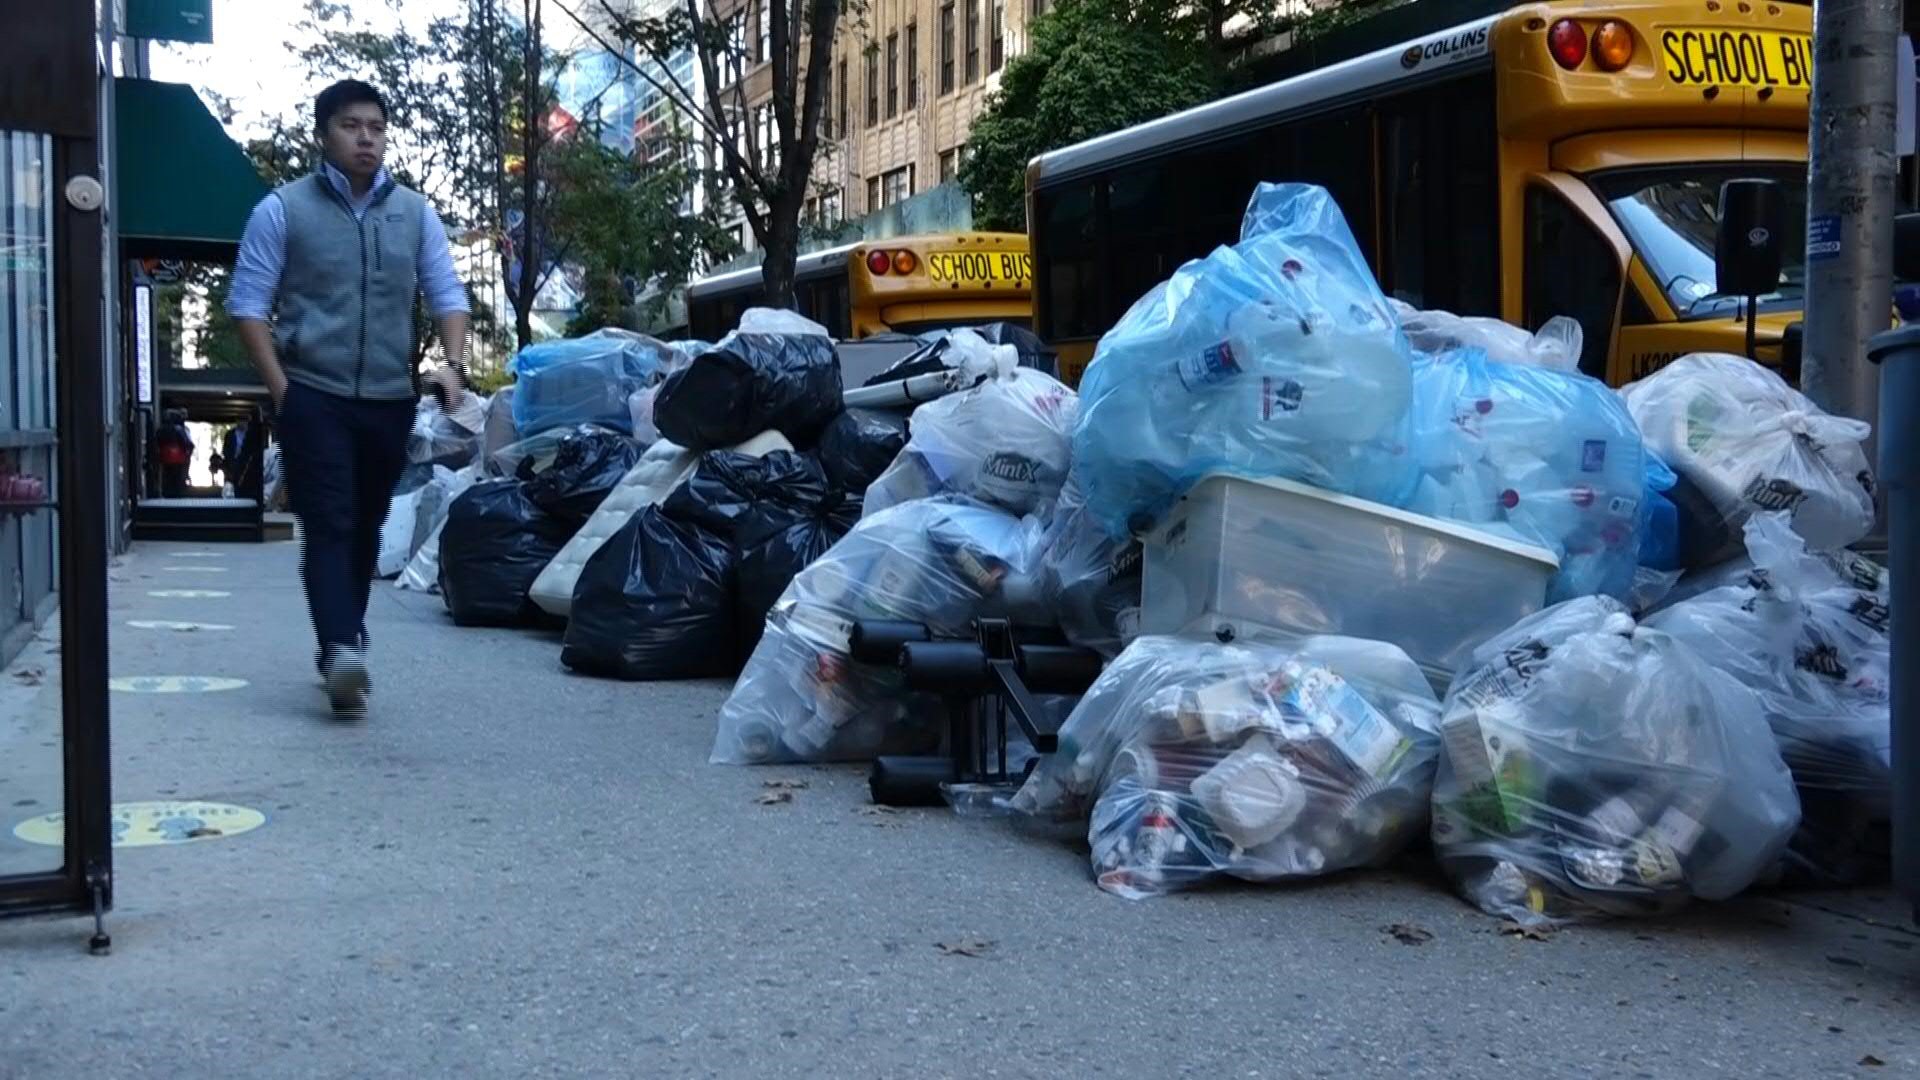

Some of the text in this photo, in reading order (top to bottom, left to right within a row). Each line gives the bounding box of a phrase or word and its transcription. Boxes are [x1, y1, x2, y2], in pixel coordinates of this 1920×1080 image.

[1424, 27, 1487, 59] COLLINS
[1662, 31, 1812, 86] SCHOOL BU
[930, 253, 1031, 281] SCHOOL BUS
